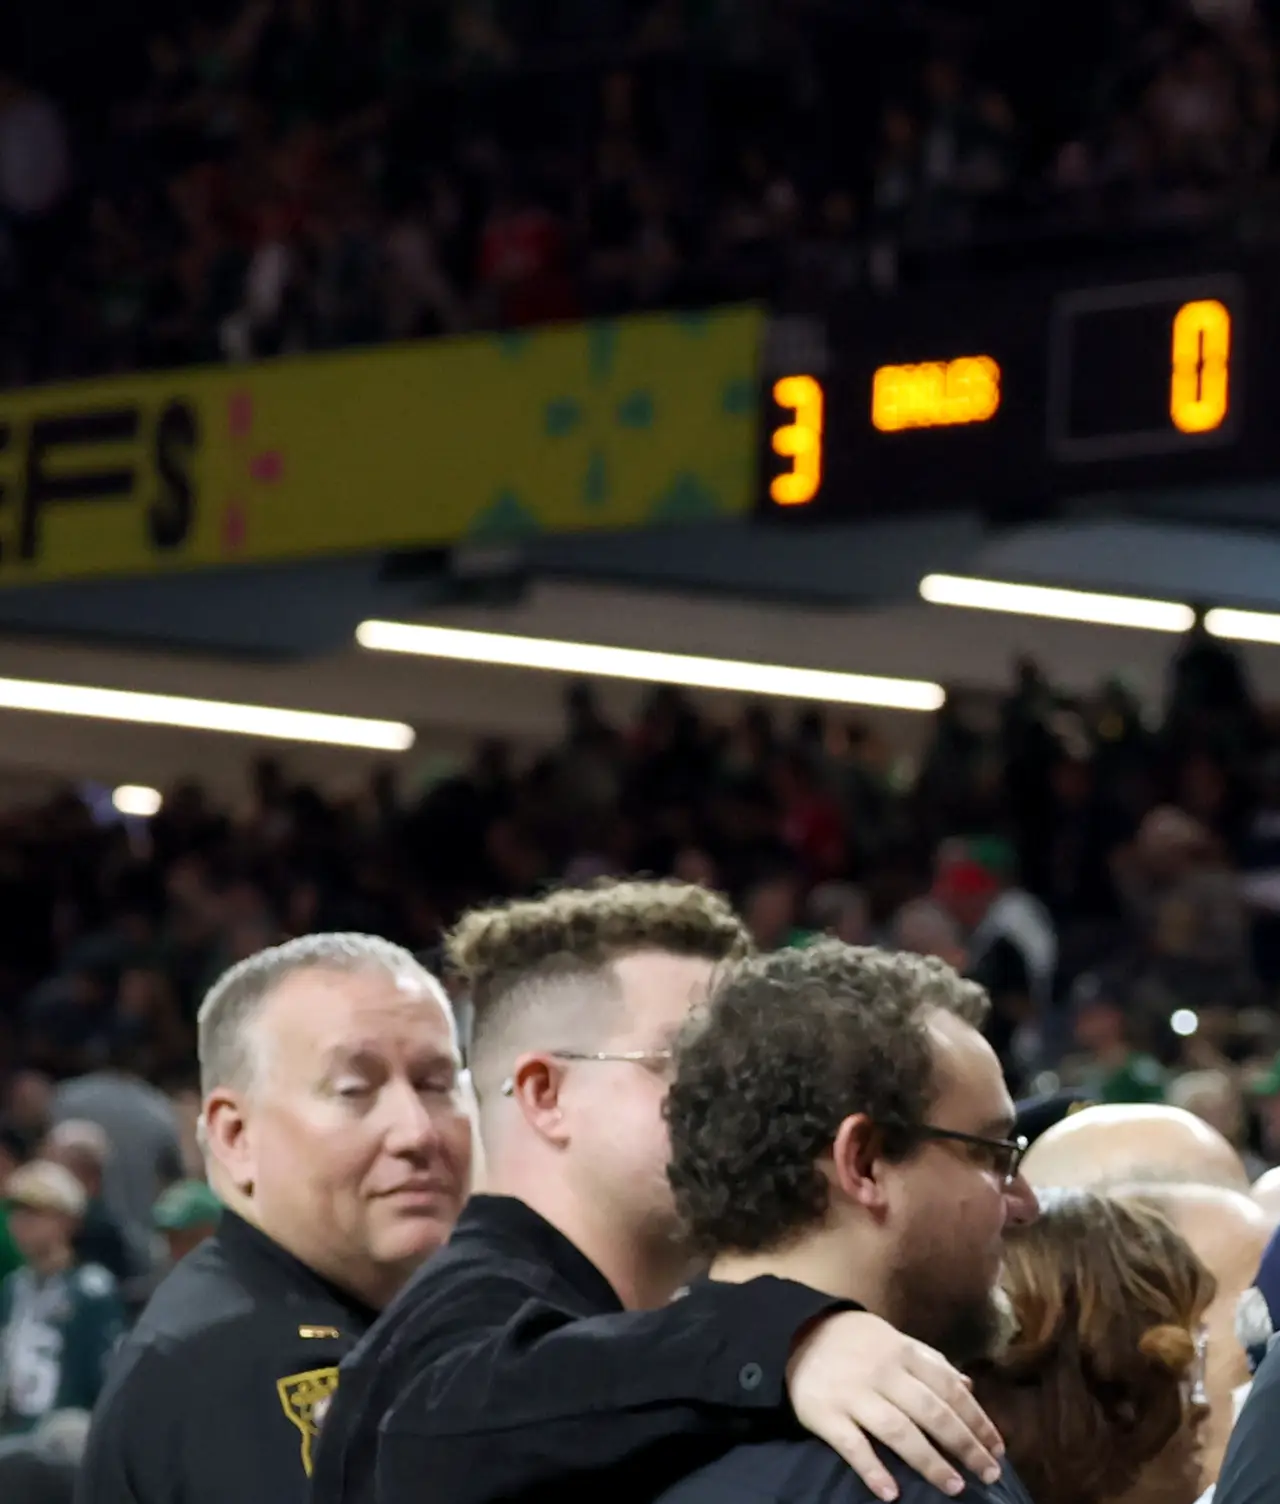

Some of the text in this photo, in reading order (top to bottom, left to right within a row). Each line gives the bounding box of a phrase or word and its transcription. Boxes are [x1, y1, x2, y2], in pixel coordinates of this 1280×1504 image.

[1169, 299, 1232, 433] 0
[0, 398, 200, 560] FS
[769, 374, 825, 506] 3
